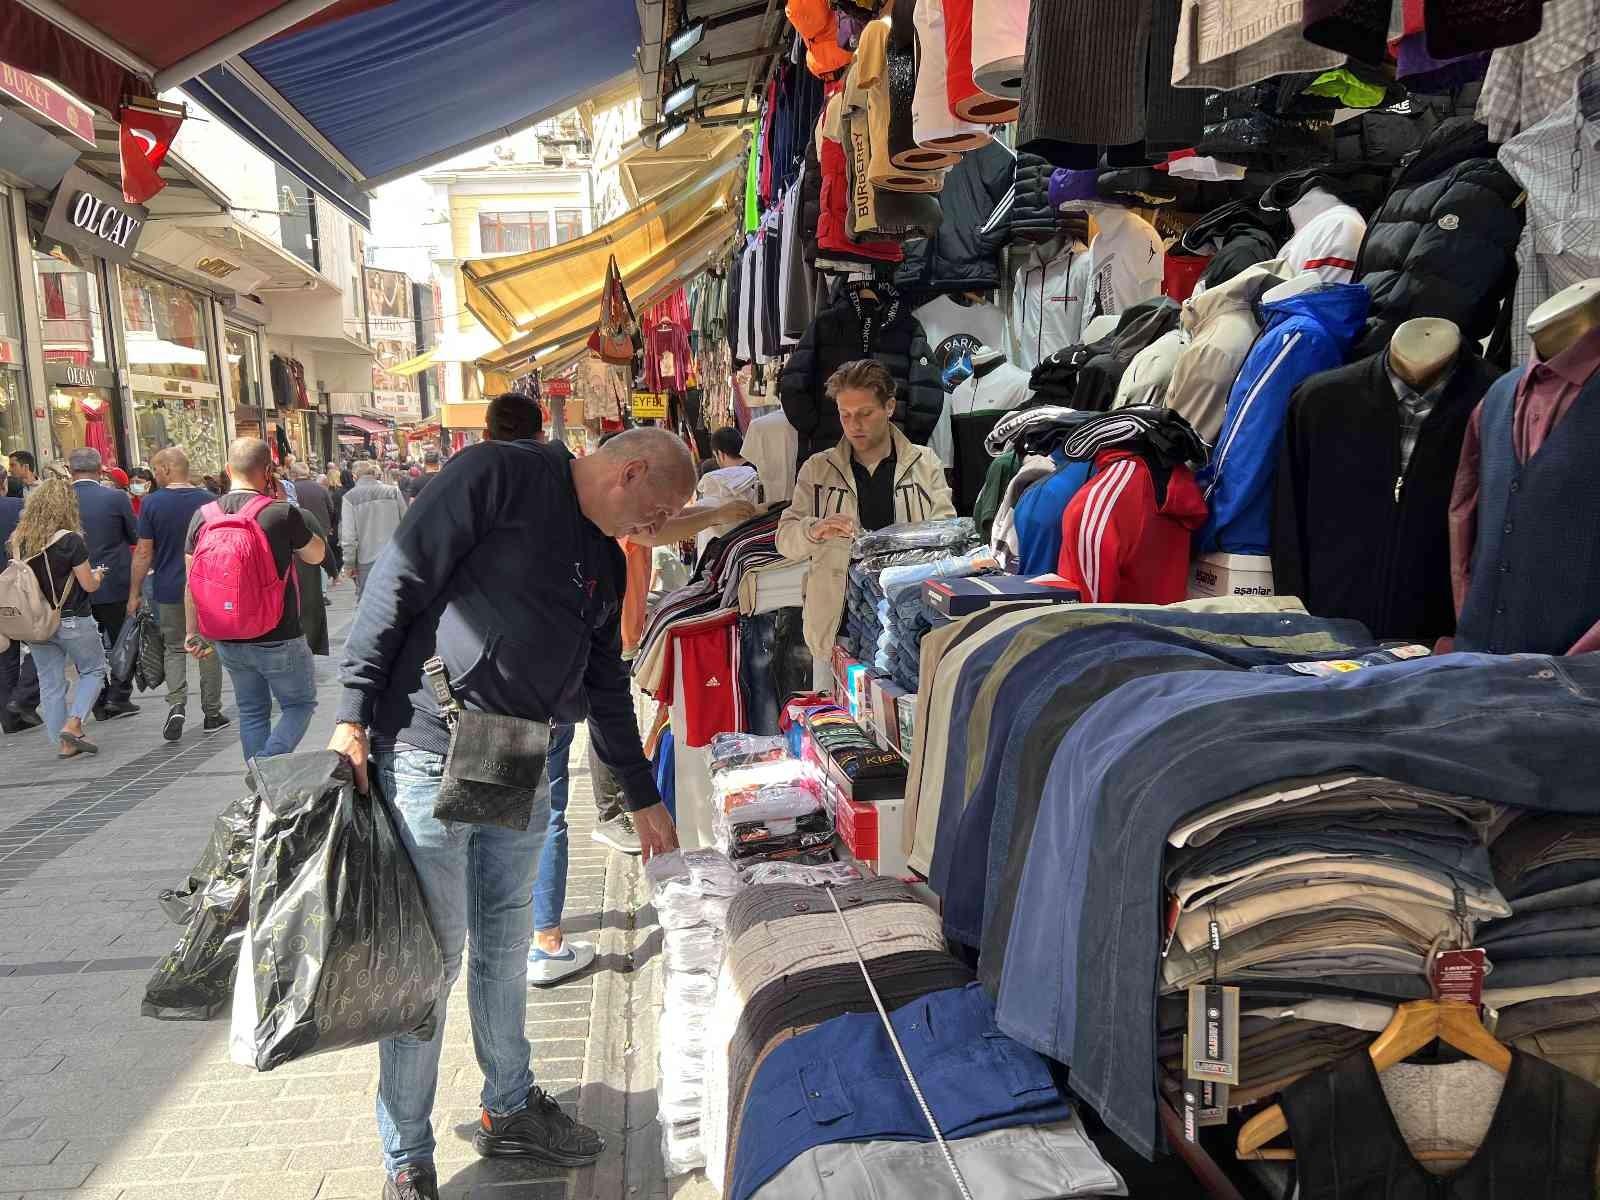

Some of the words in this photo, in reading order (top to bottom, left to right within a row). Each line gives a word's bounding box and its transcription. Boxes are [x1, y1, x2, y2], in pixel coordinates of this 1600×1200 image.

[3, 63, 50, 110] BUKET
[852, 132, 869, 218] BURBERRY
[73, 191, 140, 249] OLCAY
[943, 338, 983, 355] PARIS
[67, 366, 97, 386] OLCAY
